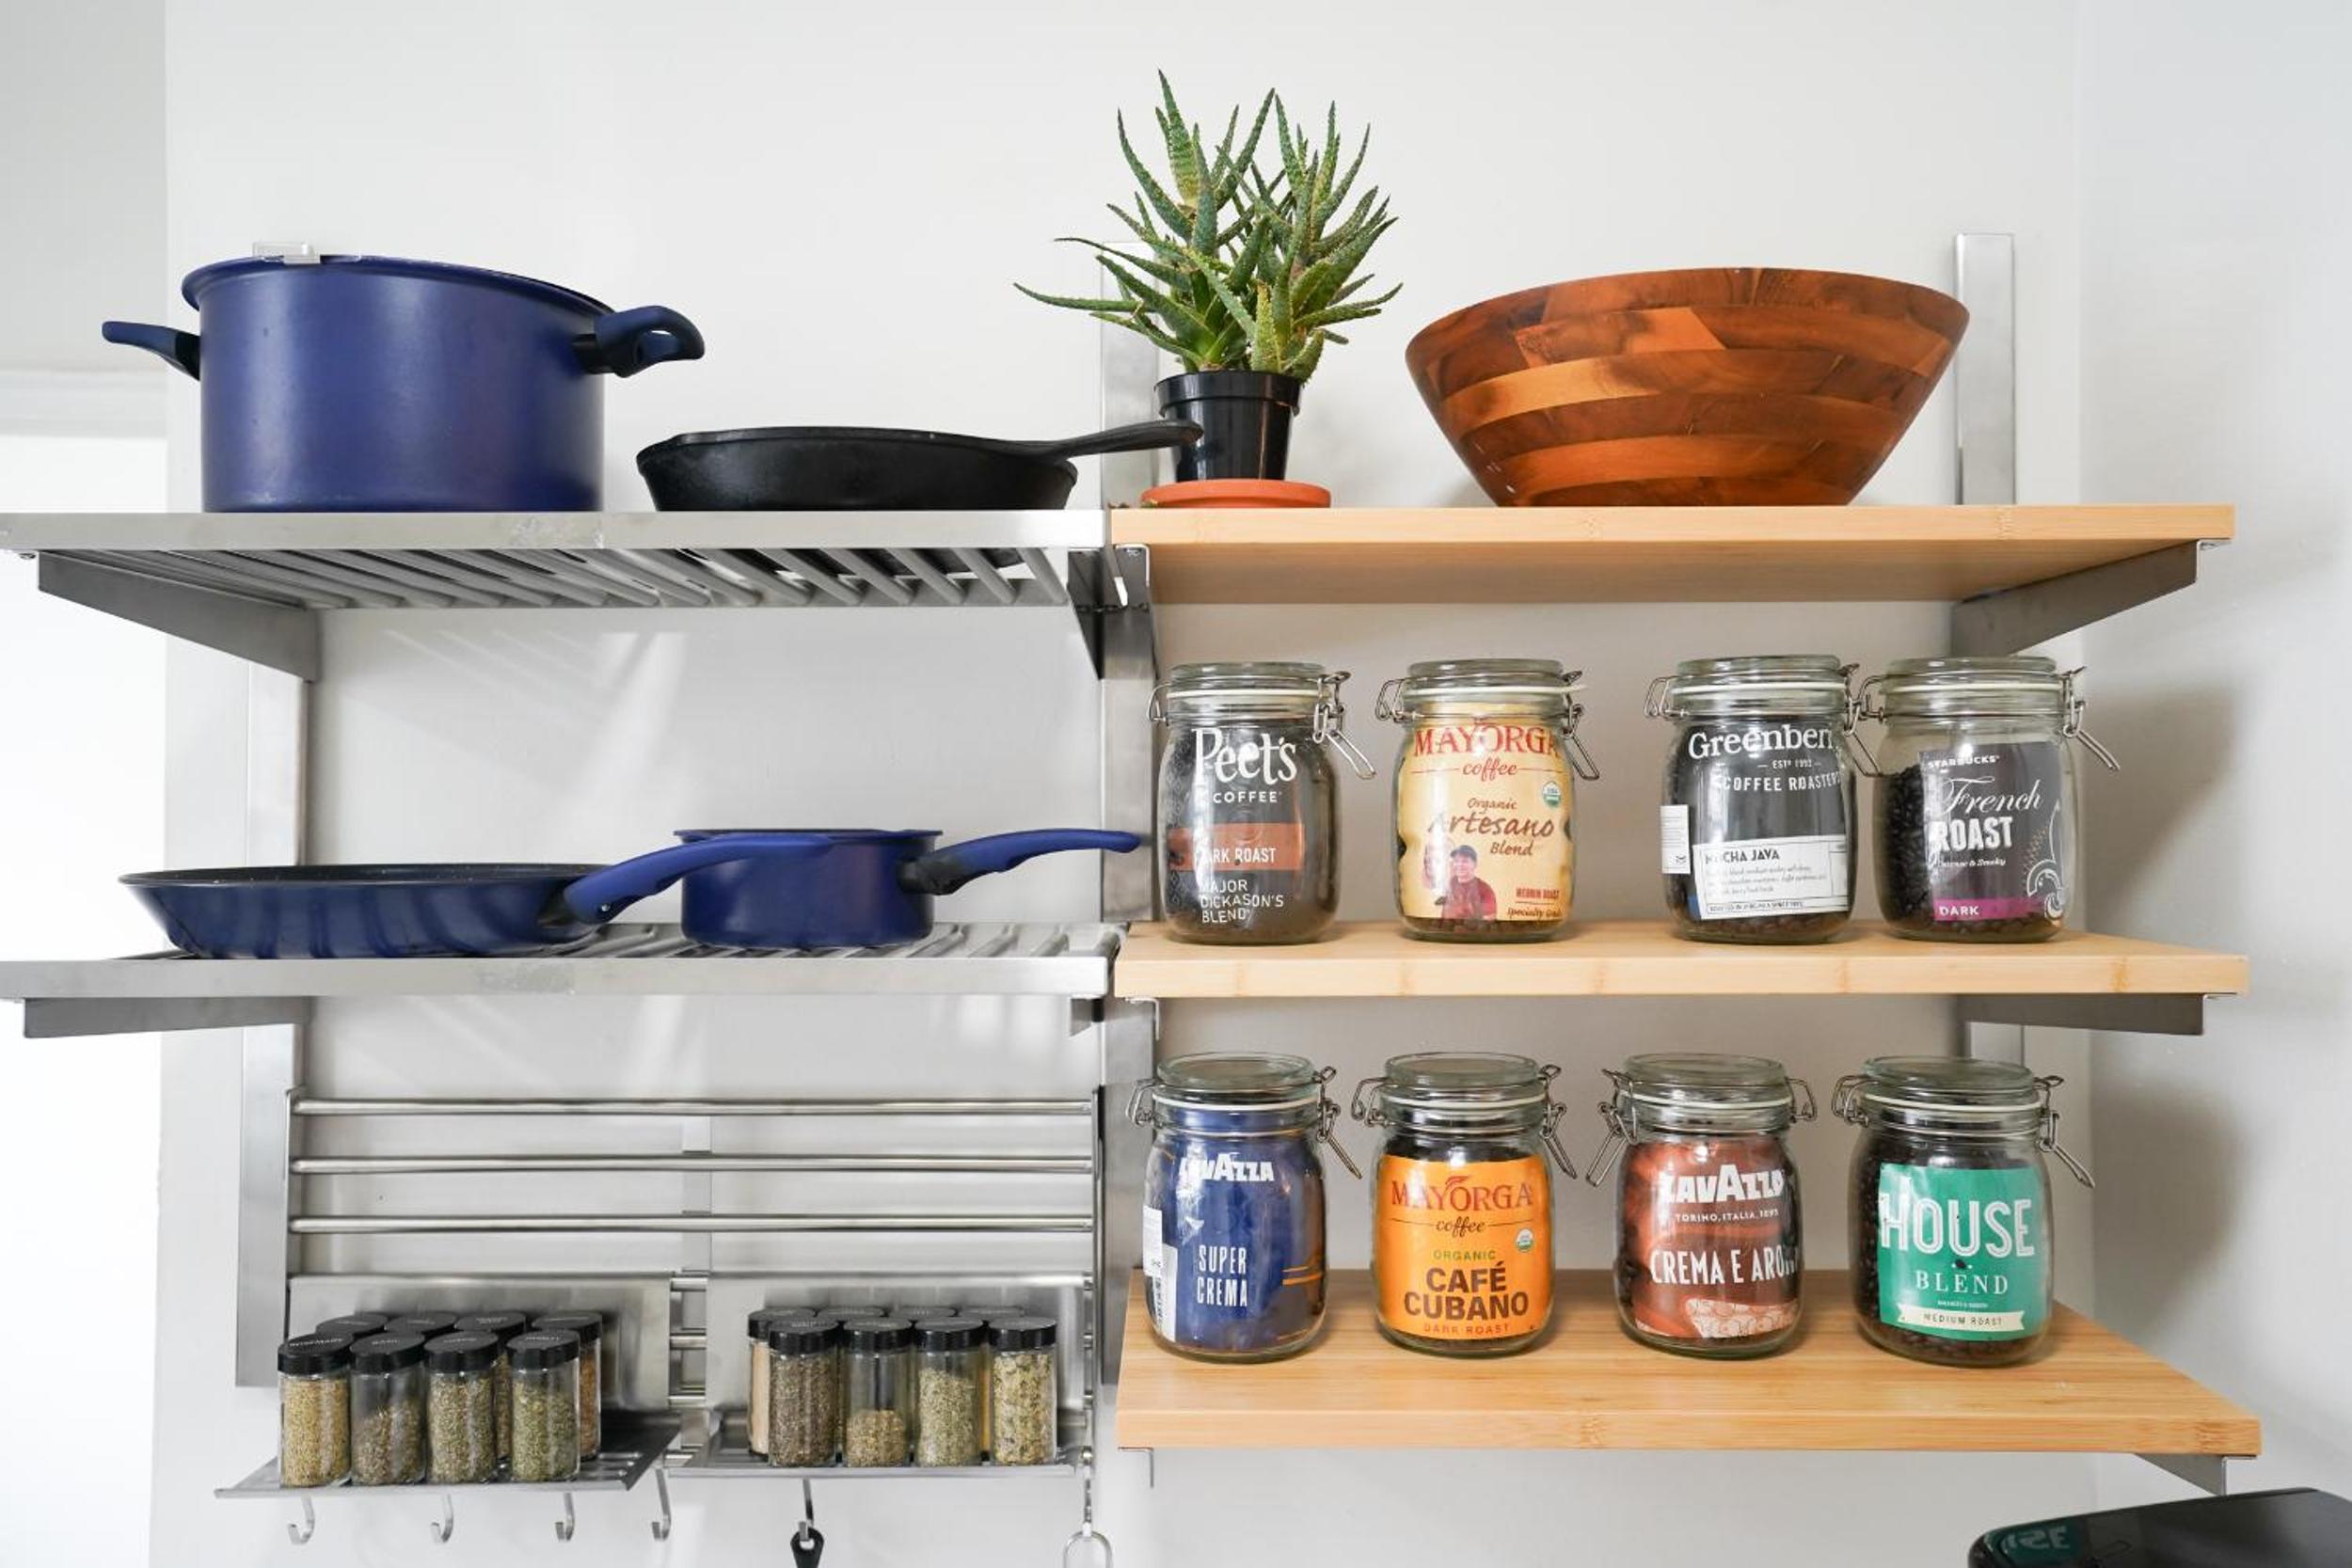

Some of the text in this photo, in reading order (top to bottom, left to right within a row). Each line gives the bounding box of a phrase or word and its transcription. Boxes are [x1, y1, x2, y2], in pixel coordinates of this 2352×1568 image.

[1191, 727, 1297, 785] Peet's
[1927, 755, 1995, 768] STARBUCKS
[1462, 757, 1518, 782] coffee
[1723, 777, 1783, 791] COFFEE
[1213, 791, 1278, 803] COFFEE
[1941, 776, 2041, 815] French
[1467, 798, 1518, 815] Organic
[1928, 816, 2012, 851] ROAST
[1201, 847, 1277, 863] RK ROAST
[1490, 840, 1534, 856] Blend
[1705, 848, 1780, 863] MCHA JAVA
[1200, 893, 1284, 910] DICKASON'S
[1939, 906, 1979, 916] DARK
[1201, 907, 1247, 924] BLEND
[1391, 1180, 1534, 1212] MAYORGA
[1436, 1216, 1486, 1238] coffee
[1879, 1192, 2035, 1258] HOUSE
[1199, 1245, 1248, 1275] SUPER
[1433, 1249, 1497, 1260] ORGANIC
[1650, 1244, 1796, 1285] CREMA E ARO
[1426, 1260, 1508, 1293] CAFÉ
[1915, 1270, 2009, 1294] BLEND
[1197, 1276, 1248, 1307] CREMA
[1404, 1291, 1530, 1321] CUBANO
[1924, 1313, 2003, 1326] MEDIUM ROAST
[1423, 1323, 1510, 1336] DARK ROAST
